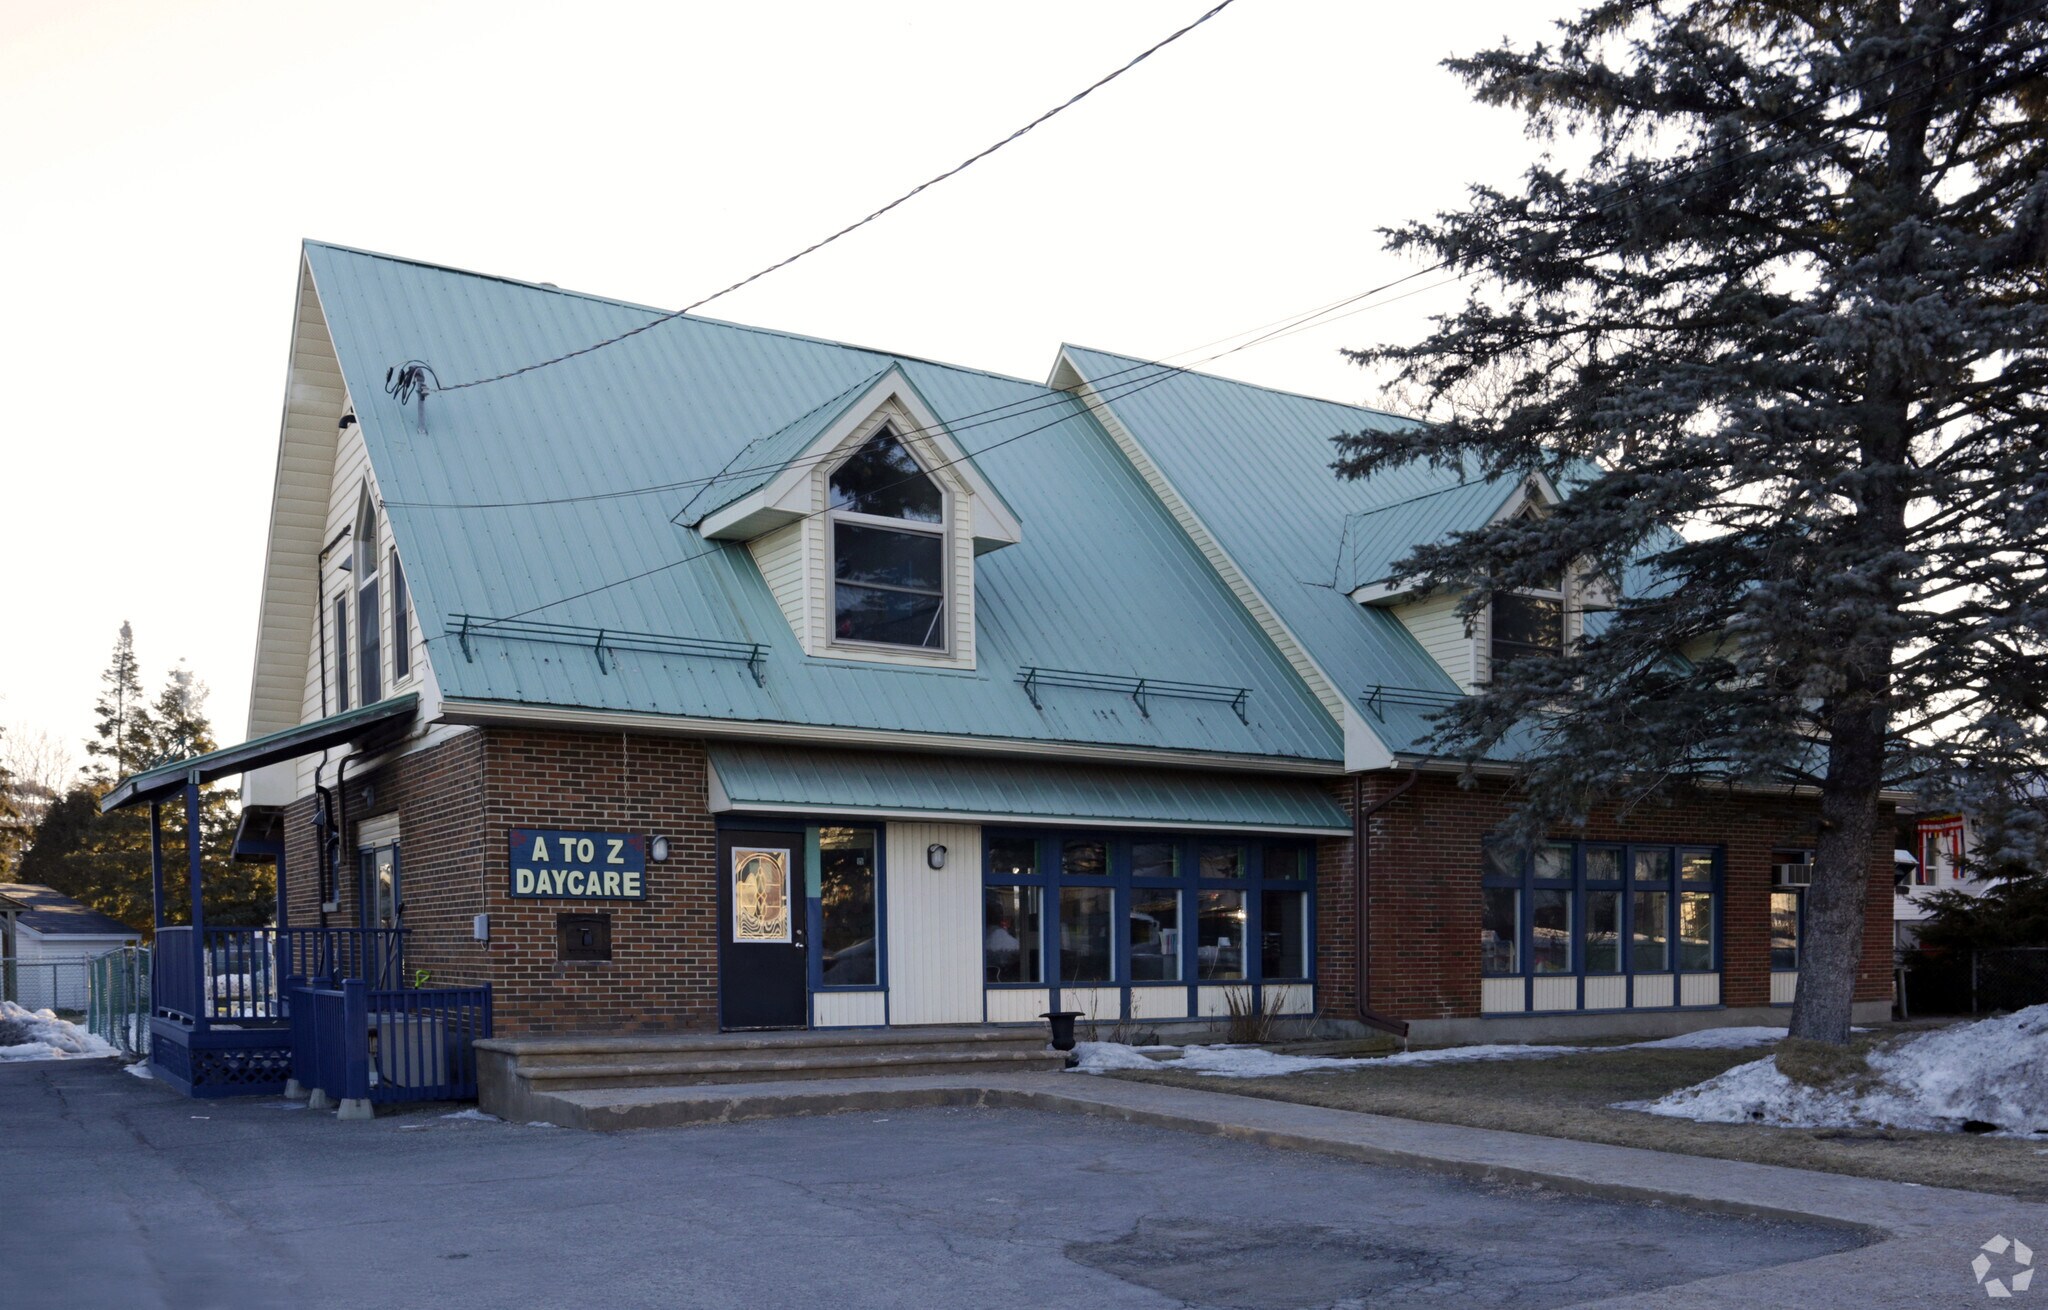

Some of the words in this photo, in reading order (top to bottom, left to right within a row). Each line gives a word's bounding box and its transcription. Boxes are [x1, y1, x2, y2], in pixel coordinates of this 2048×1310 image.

[532, 836, 549, 861] A
[559, 837, 595, 863] TO
[607, 839, 624, 864] Z
[516, 868, 640, 896] DAYCARE
